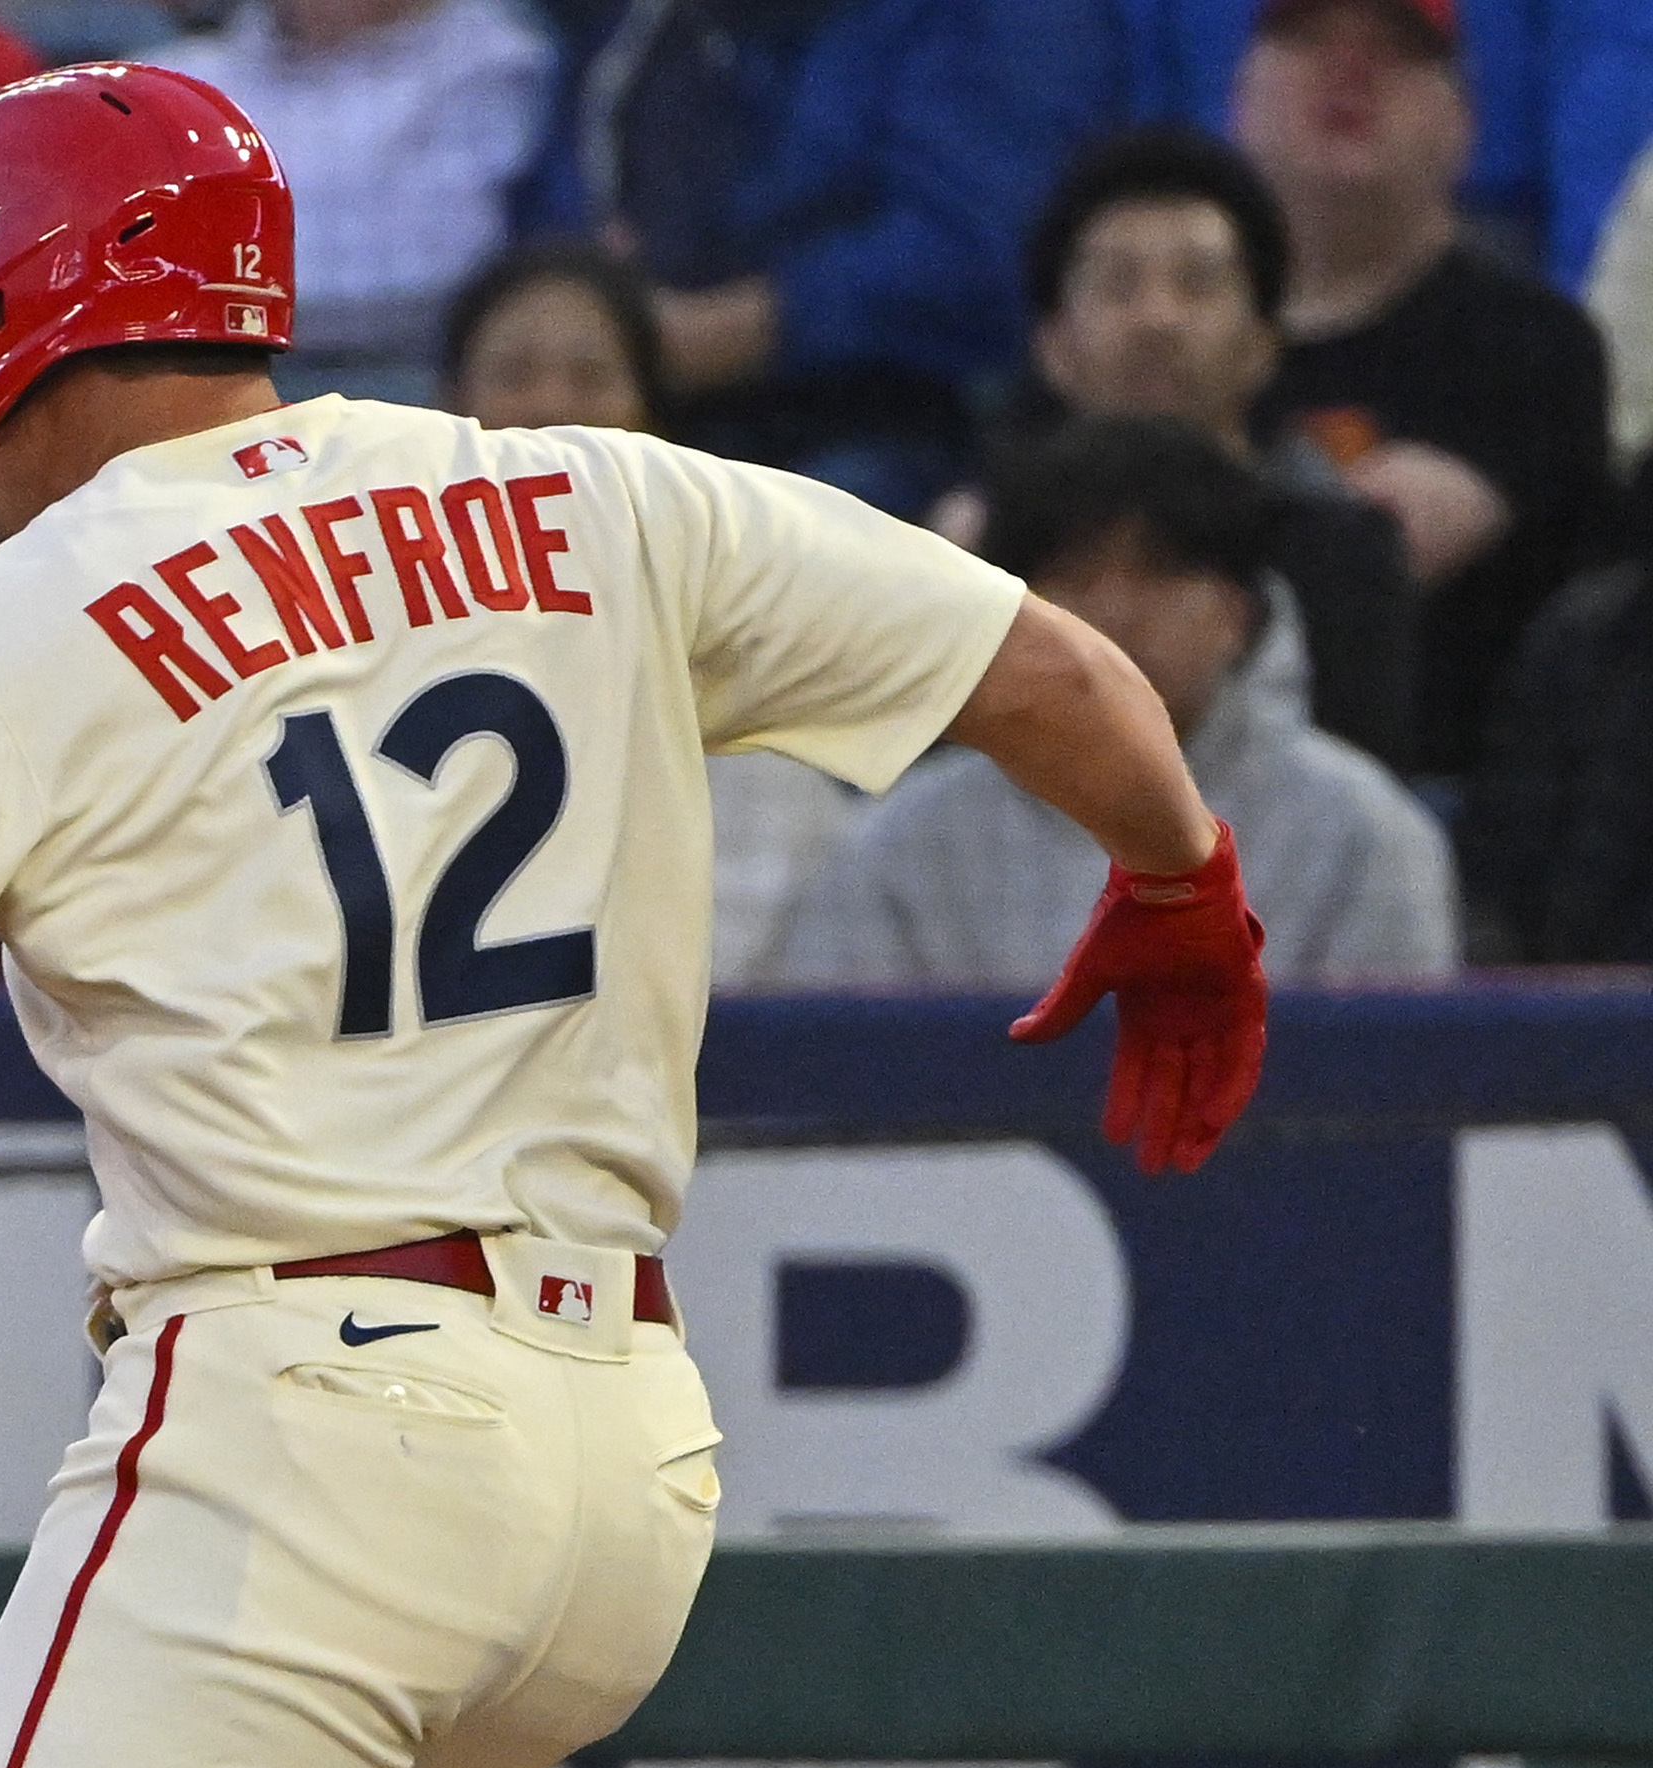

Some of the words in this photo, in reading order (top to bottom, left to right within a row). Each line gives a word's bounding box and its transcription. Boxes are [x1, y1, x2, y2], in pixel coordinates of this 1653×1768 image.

[232, 242, 263, 280] 12
[83, 471, 594, 723] RENFROE
[259, 667, 598, 1042] 12
